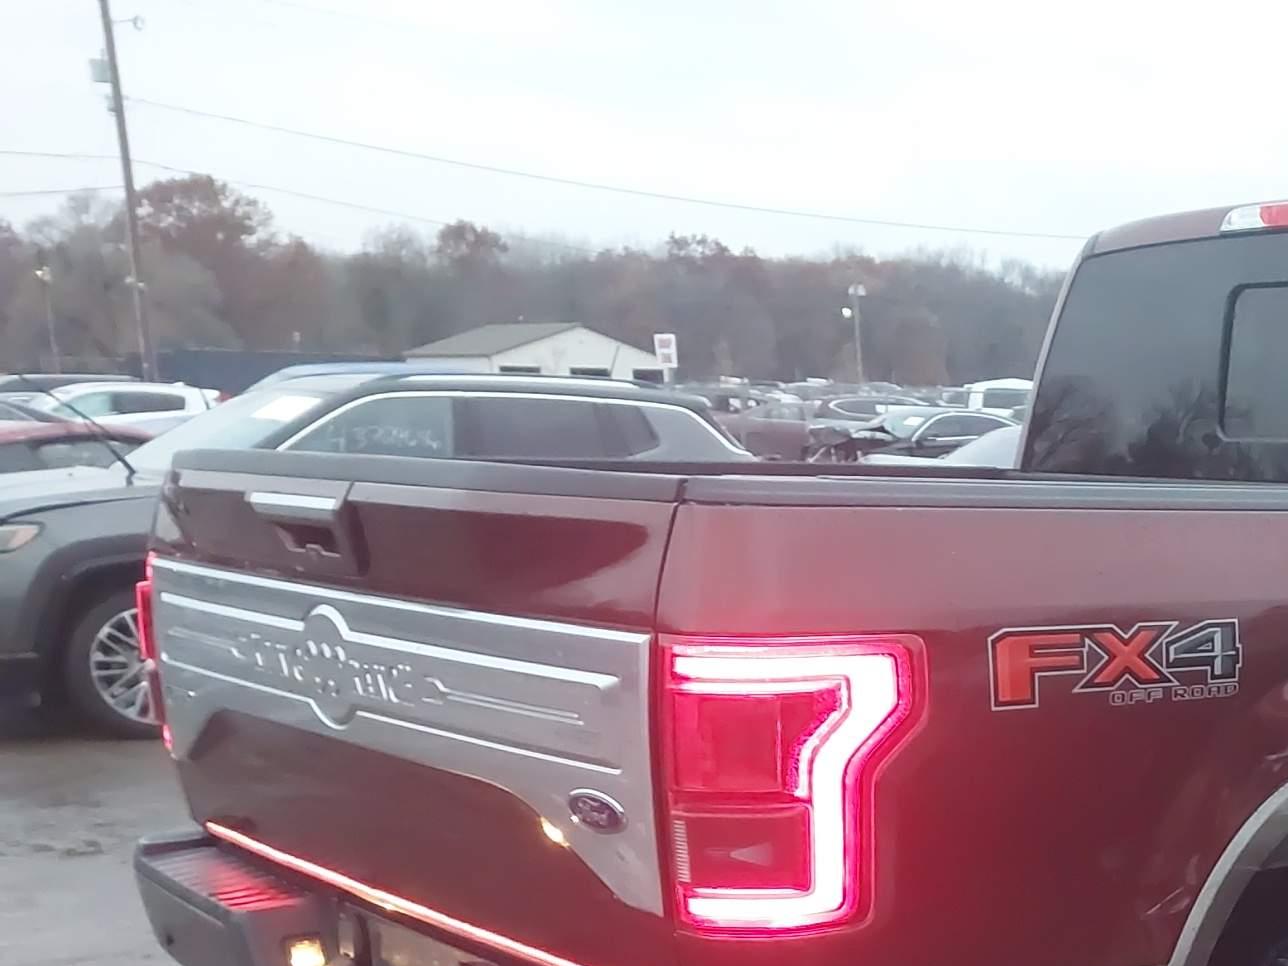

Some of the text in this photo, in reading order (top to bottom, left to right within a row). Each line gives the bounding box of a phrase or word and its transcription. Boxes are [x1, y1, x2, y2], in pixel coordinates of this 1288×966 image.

[987, 617, 1242, 711] FX4
[1108, 682, 1239, 706] OFF ROAD
